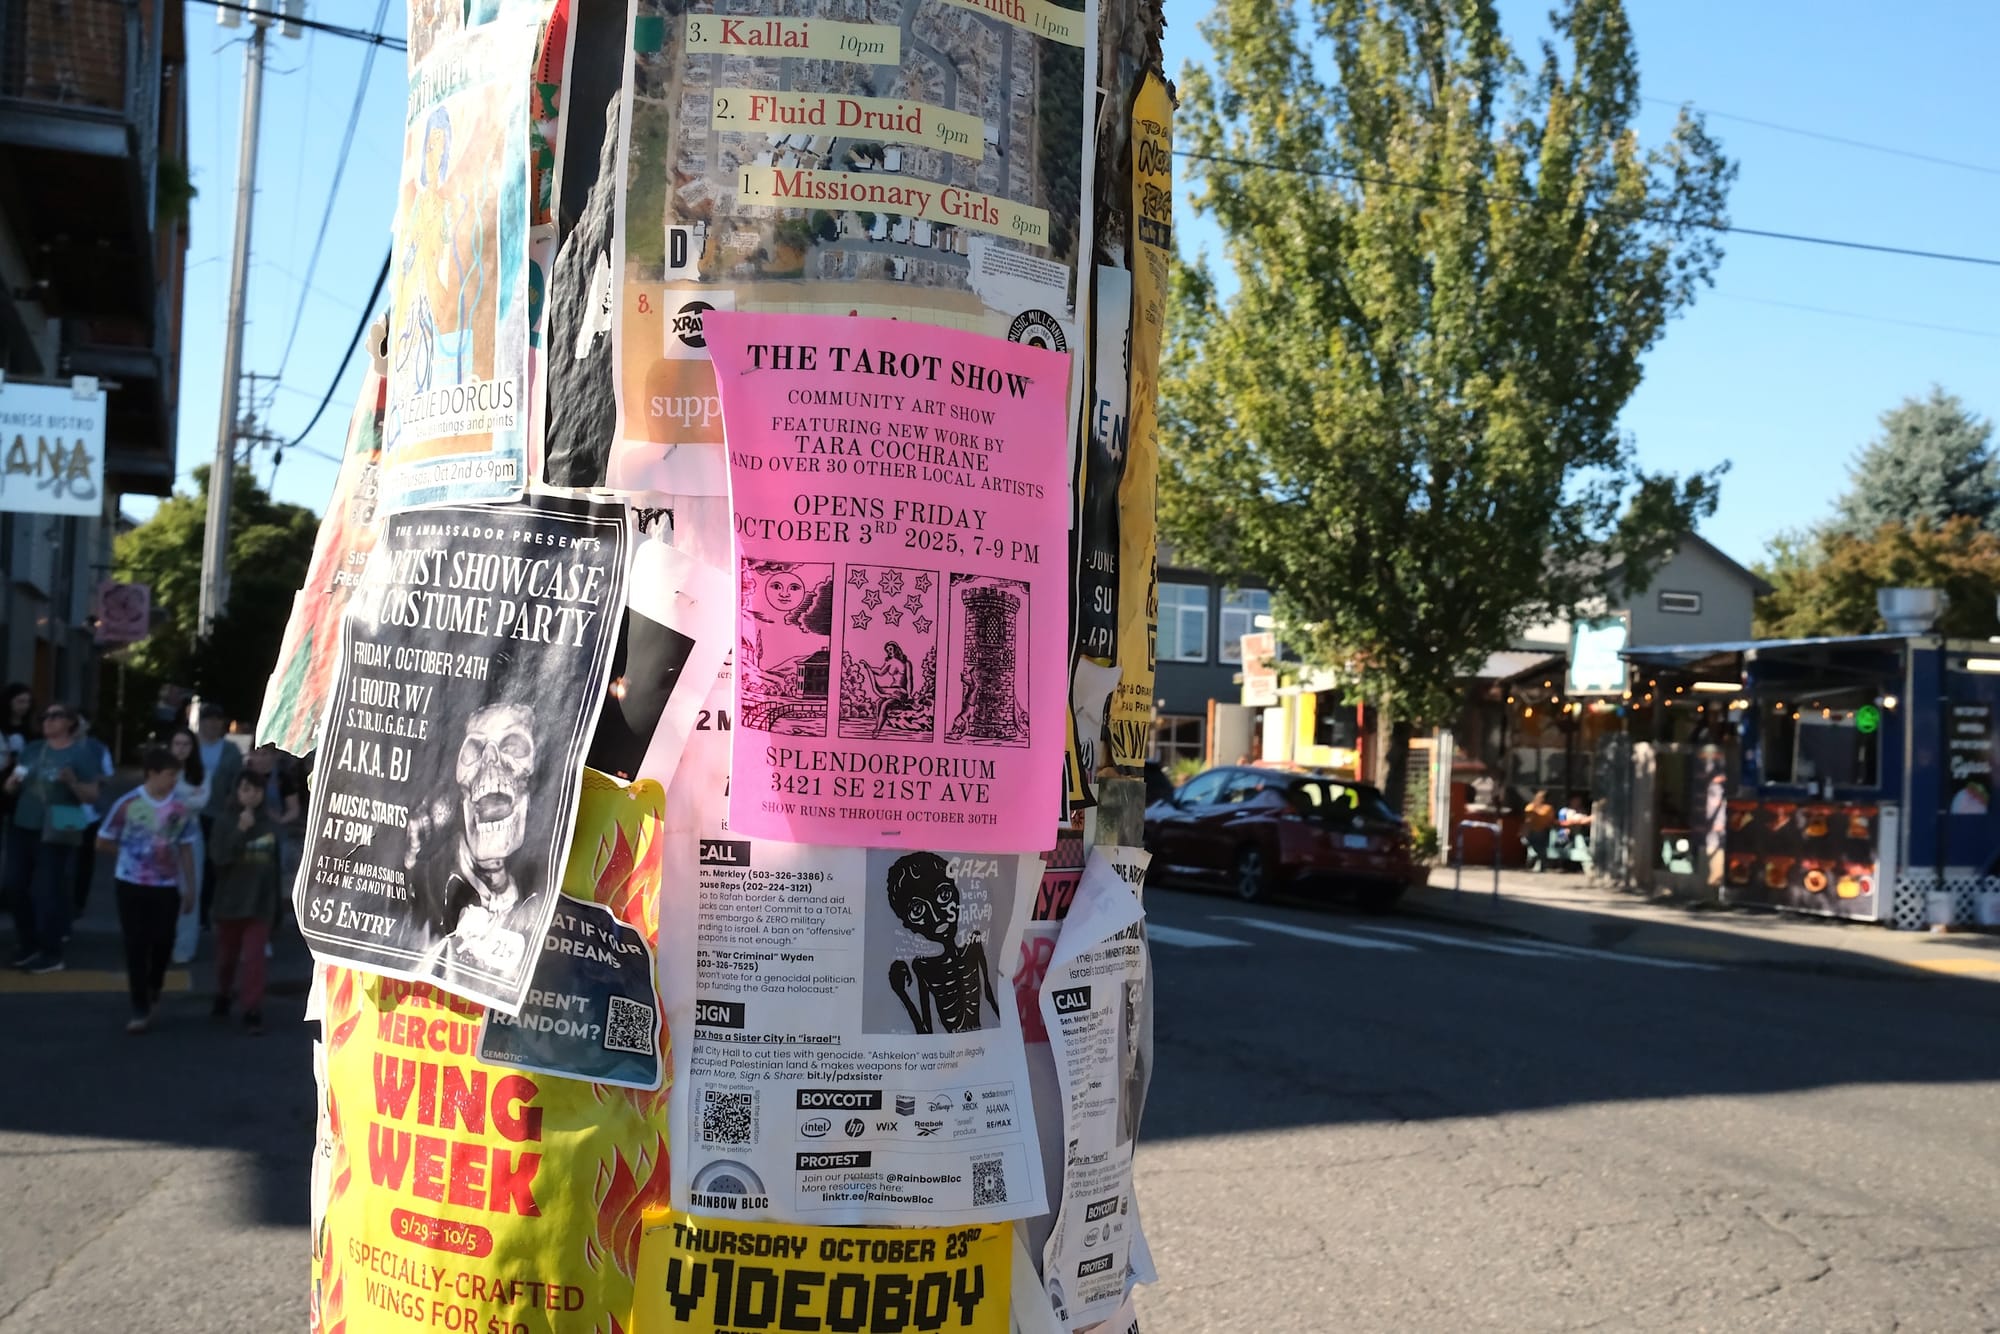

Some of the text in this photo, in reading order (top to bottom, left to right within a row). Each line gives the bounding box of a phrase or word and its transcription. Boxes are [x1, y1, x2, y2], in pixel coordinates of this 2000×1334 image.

[689, 19, 885, 55] 3. Kallai 10pm
[716, 95, 970, 144] 2. Fluid Druid 9pm
[742, 169, 1042, 236] 1. Missionary Girls 8pm
[1009, 314, 1029, 342] MUSIC
[747, 344, 1031, 400] THE TAROT SHOW
[439, 380, 513, 416] DORCUS
[788, 389, 995, 426] COMMUNITY ART SHOW
[467, 413, 514, 433] and prints
[771, 416, 1005, 454] FEATURING NEW WORK BY
[0, 433, 94, 482] ANA
[450, 460, 472, 480] 2nd
[475, 460, 514, 482] 6-9pm
[795, 435, 989, 473] TARA COCHRANE
[730, 453, 1045, 500] AND OVER 30 OTHER LOCAL ARTISTS
[793, 494, 987, 531] OPENS FRIDAY
[395, 525, 601, 552] THE AMBASSADOR PRESENTS
[733, 513, 850, 544] OCTOBER
[904, 526, 966, 554] 2025,
[972, 536, 1005, 558] 7-9
[1010, 537, 1040, 565] PM
[384, 549, 605, 606] RTIST SHOWCASE
[380, 590, 492, 637] COSTUME
[494, 600, 596, 648] PARTY
[354, 642, 489, 680] FRIDAY, OCTOBER 24TH
[350, 676, 357, 703] 1
[360, 678, 400, 710] HOUR
[338, 738, 412, 782] A.K.A. BJ
[765, 746, 997, 780] SPLENDORPORIUM
[771, 773, 990, 804] 3421 SE 21ST AVE
[328, 792, 408, 828] MUSIC STARTS
[761, 800, 998, 825] SHOW RUNS THROUGH OCTOBER 30TH
[322, 818, 373, 846] AT 9PM
[315, 871, 339, 886] 4744
[342, 877, 353, 889] NE
[355, 877, 386, 896] SANDY
[317, 855, 405, 884] AT THE AMBASSADOR
[713, 869, 746, 880] Merkley
[946, 857, 999, 883] GAZA
[720, 882, 812, 894] Reps (202-224-3121)
[310, 897, 334, 924] $5
[552, 913, 643, 956] AT IF YOUR
[544, 935, 622, 969] DREAMS
[1056, 991, 1087, 1010] CALL
[492, 1010, 601, 1041] RANDOM?
[708, 1032, 723, 1040] has
[733, 1033, 761, 1042] Sister
[764, 1034, 783, 1044] City
[786, 1034, 796, 1042] in
[807, 1068, 883, 1082] bit.ly/pdxsister
[373, 1052, 543, 1143] WING
[801, 1094, 873, 1106] BOYCOTT
[914, 1119, 943, 1127] Reebok
[368, 1122, 542, 1217] WEEK
[800, 1154, 858, 1167] PROTEST
[801, 1182, 904, 1192] More resources here:
[802, 1172, 962, 1184] Join our protests @RainbowBloc
[691, 1193, 768, 1209] RAINBOW BLOC
[823, 1191, 934, 1204] linktr.ee/RainbowBloc
[400, 1217, 429, 1241] 9/29
[443, 1227, 477, 1252] 10/5
[673, 1223, 808, 1259] THURSDAY
[819, 1237, 937, 1263] OCTOBER
[1080, 1258, 1109, 1275] PROTEST
[366, 1278, 424, 1322] WINGS
[432, 1302, 479, 1334] FOR
